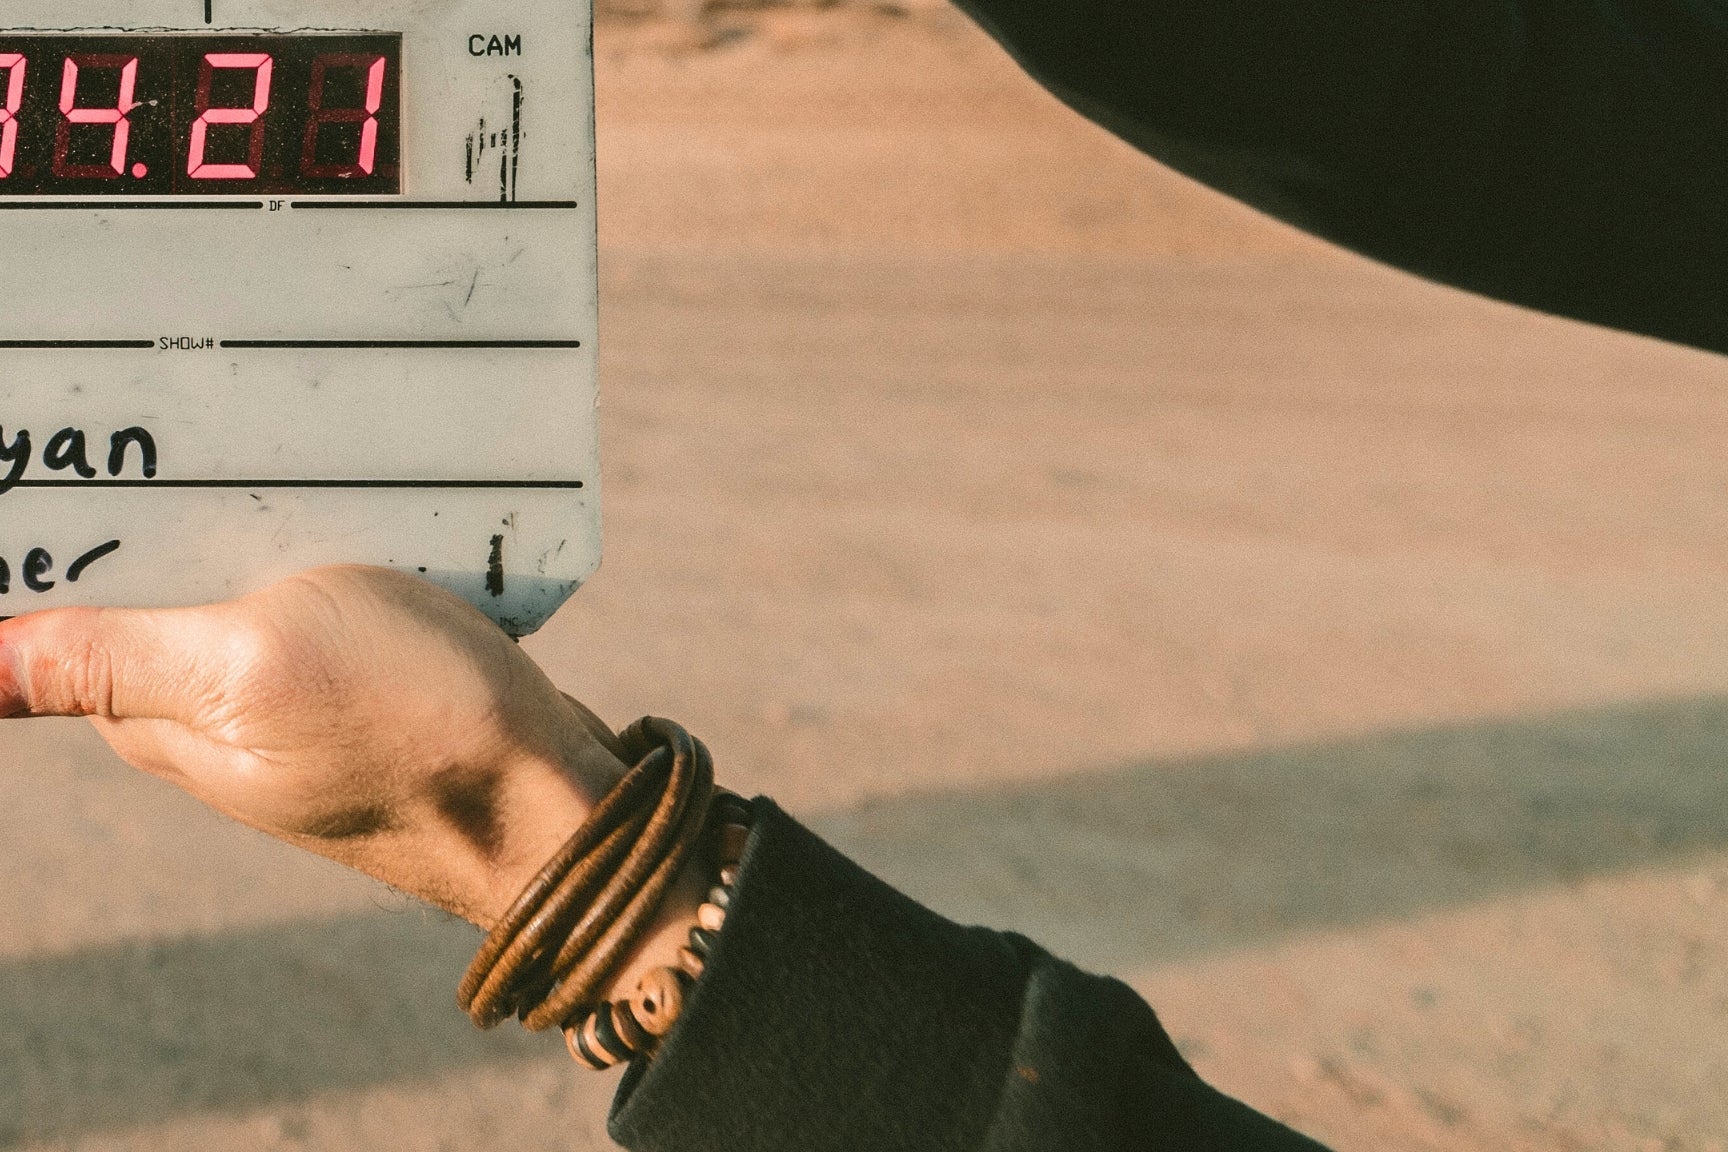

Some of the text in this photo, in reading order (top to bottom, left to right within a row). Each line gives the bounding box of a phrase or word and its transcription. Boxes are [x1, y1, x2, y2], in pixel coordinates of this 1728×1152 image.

[468, 34, 522, 57] CAM
[268, 198, 286, 213] DF
[159, 336, 214, 350] SHOW#
